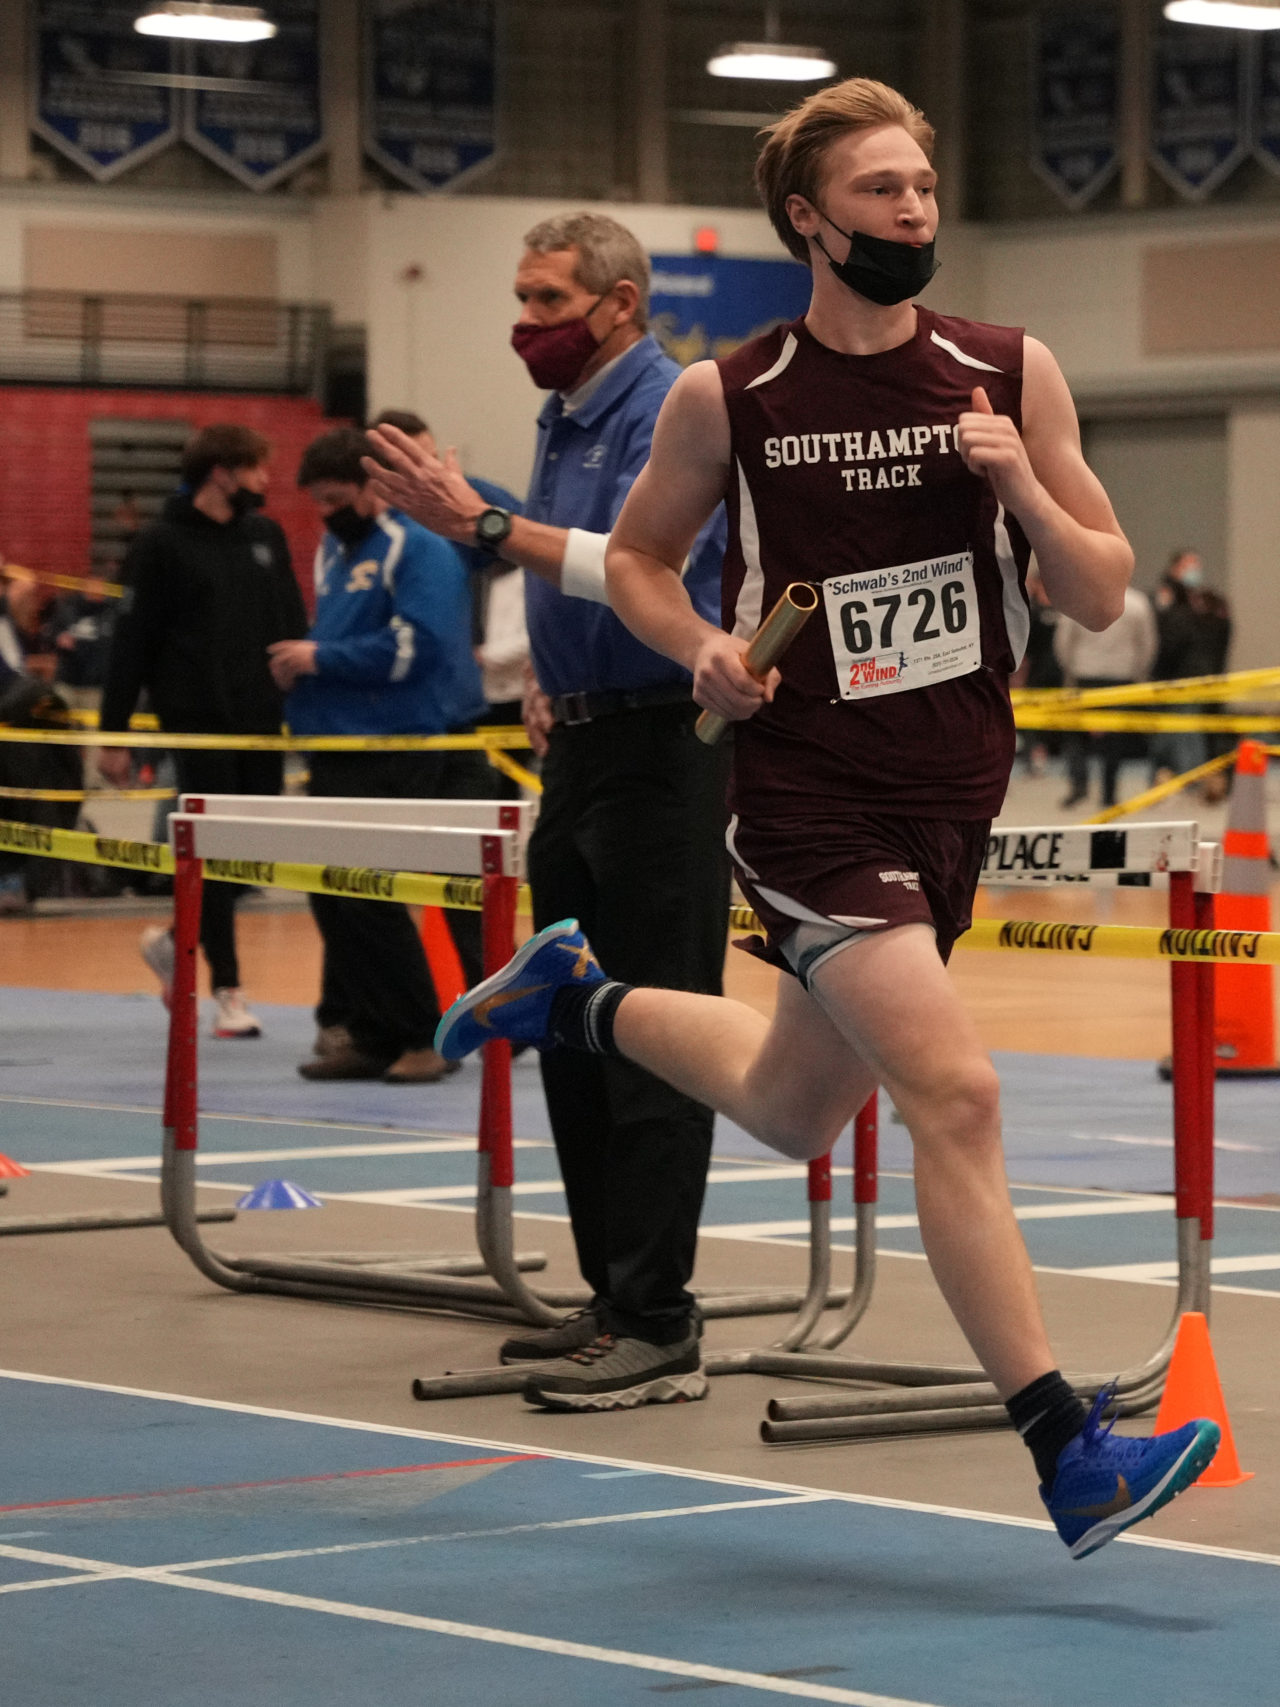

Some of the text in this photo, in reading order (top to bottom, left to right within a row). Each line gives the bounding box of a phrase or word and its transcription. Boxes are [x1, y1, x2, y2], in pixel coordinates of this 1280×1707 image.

[841, 464, 922, 492] TRACK
[832, 572, 899, 596] Schwab's
[902, 565, 928, 584] 2nd
[931, 557, 963, 578] Wind
[839, 580, 967, 654] 6726
[850, 656, 897, 686] 2nd WIND
[982, 832, 1064, 870] PLACE
[1000, 920, 1098, 951] CAUTION
[1159, 929, 1263, 958] CAUTION
